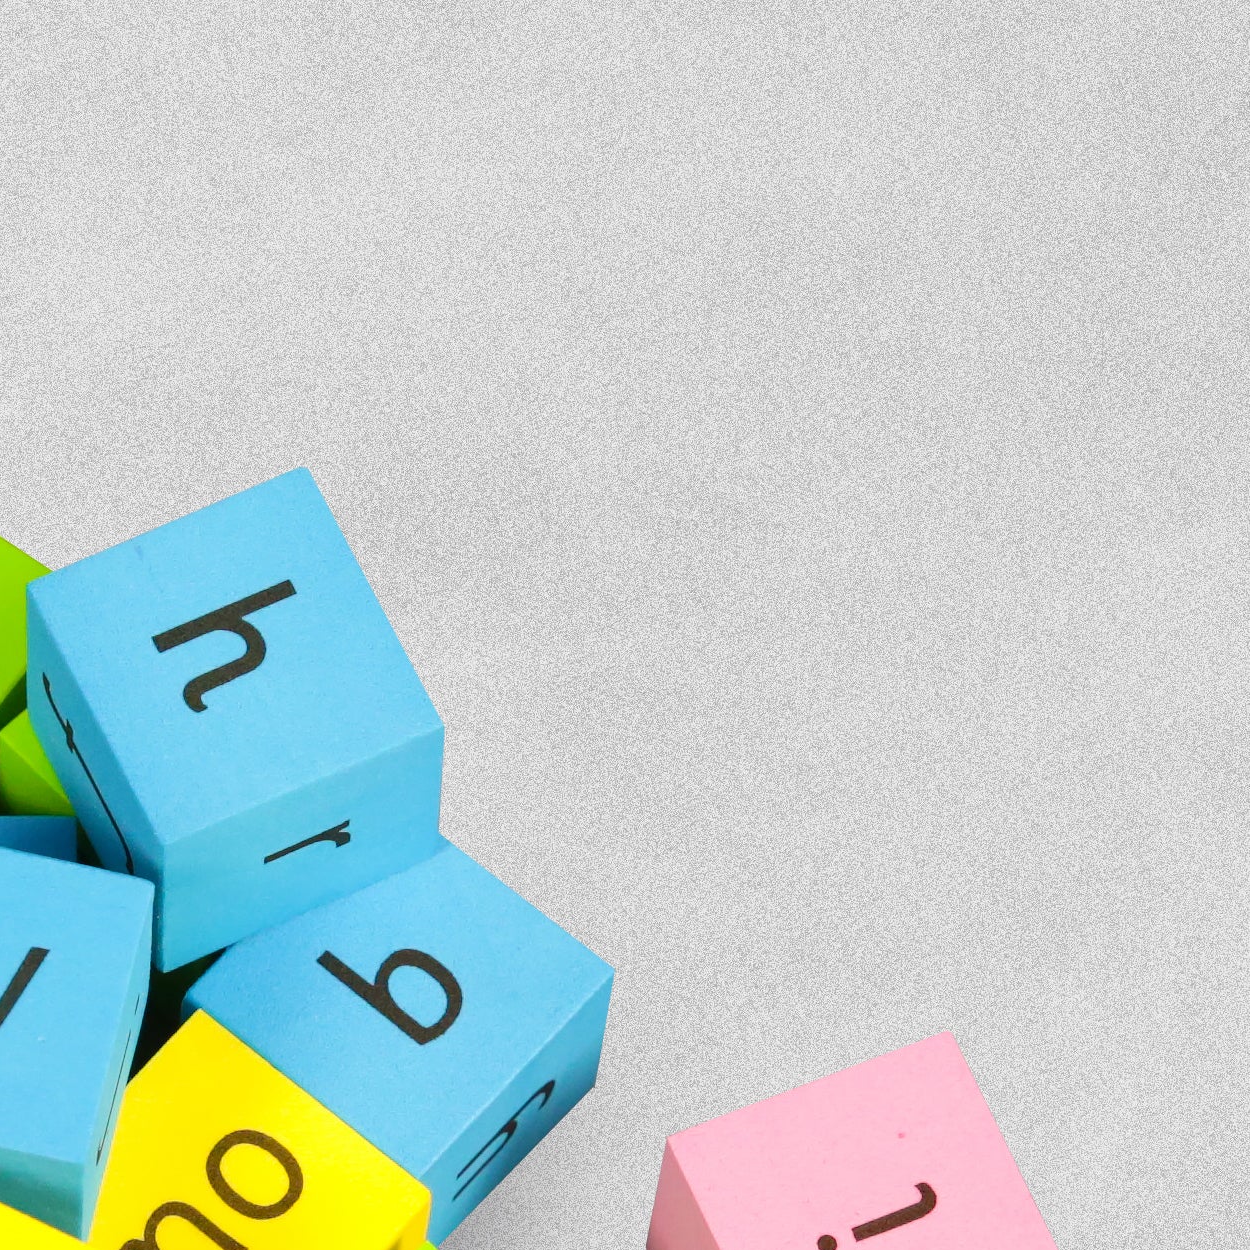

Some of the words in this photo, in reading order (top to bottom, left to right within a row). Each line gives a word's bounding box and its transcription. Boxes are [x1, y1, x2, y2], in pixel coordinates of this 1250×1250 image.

[150, 578, 298, 714] h
[261, 817, 353, 866] r
[314, 946, 464, 1047] b
